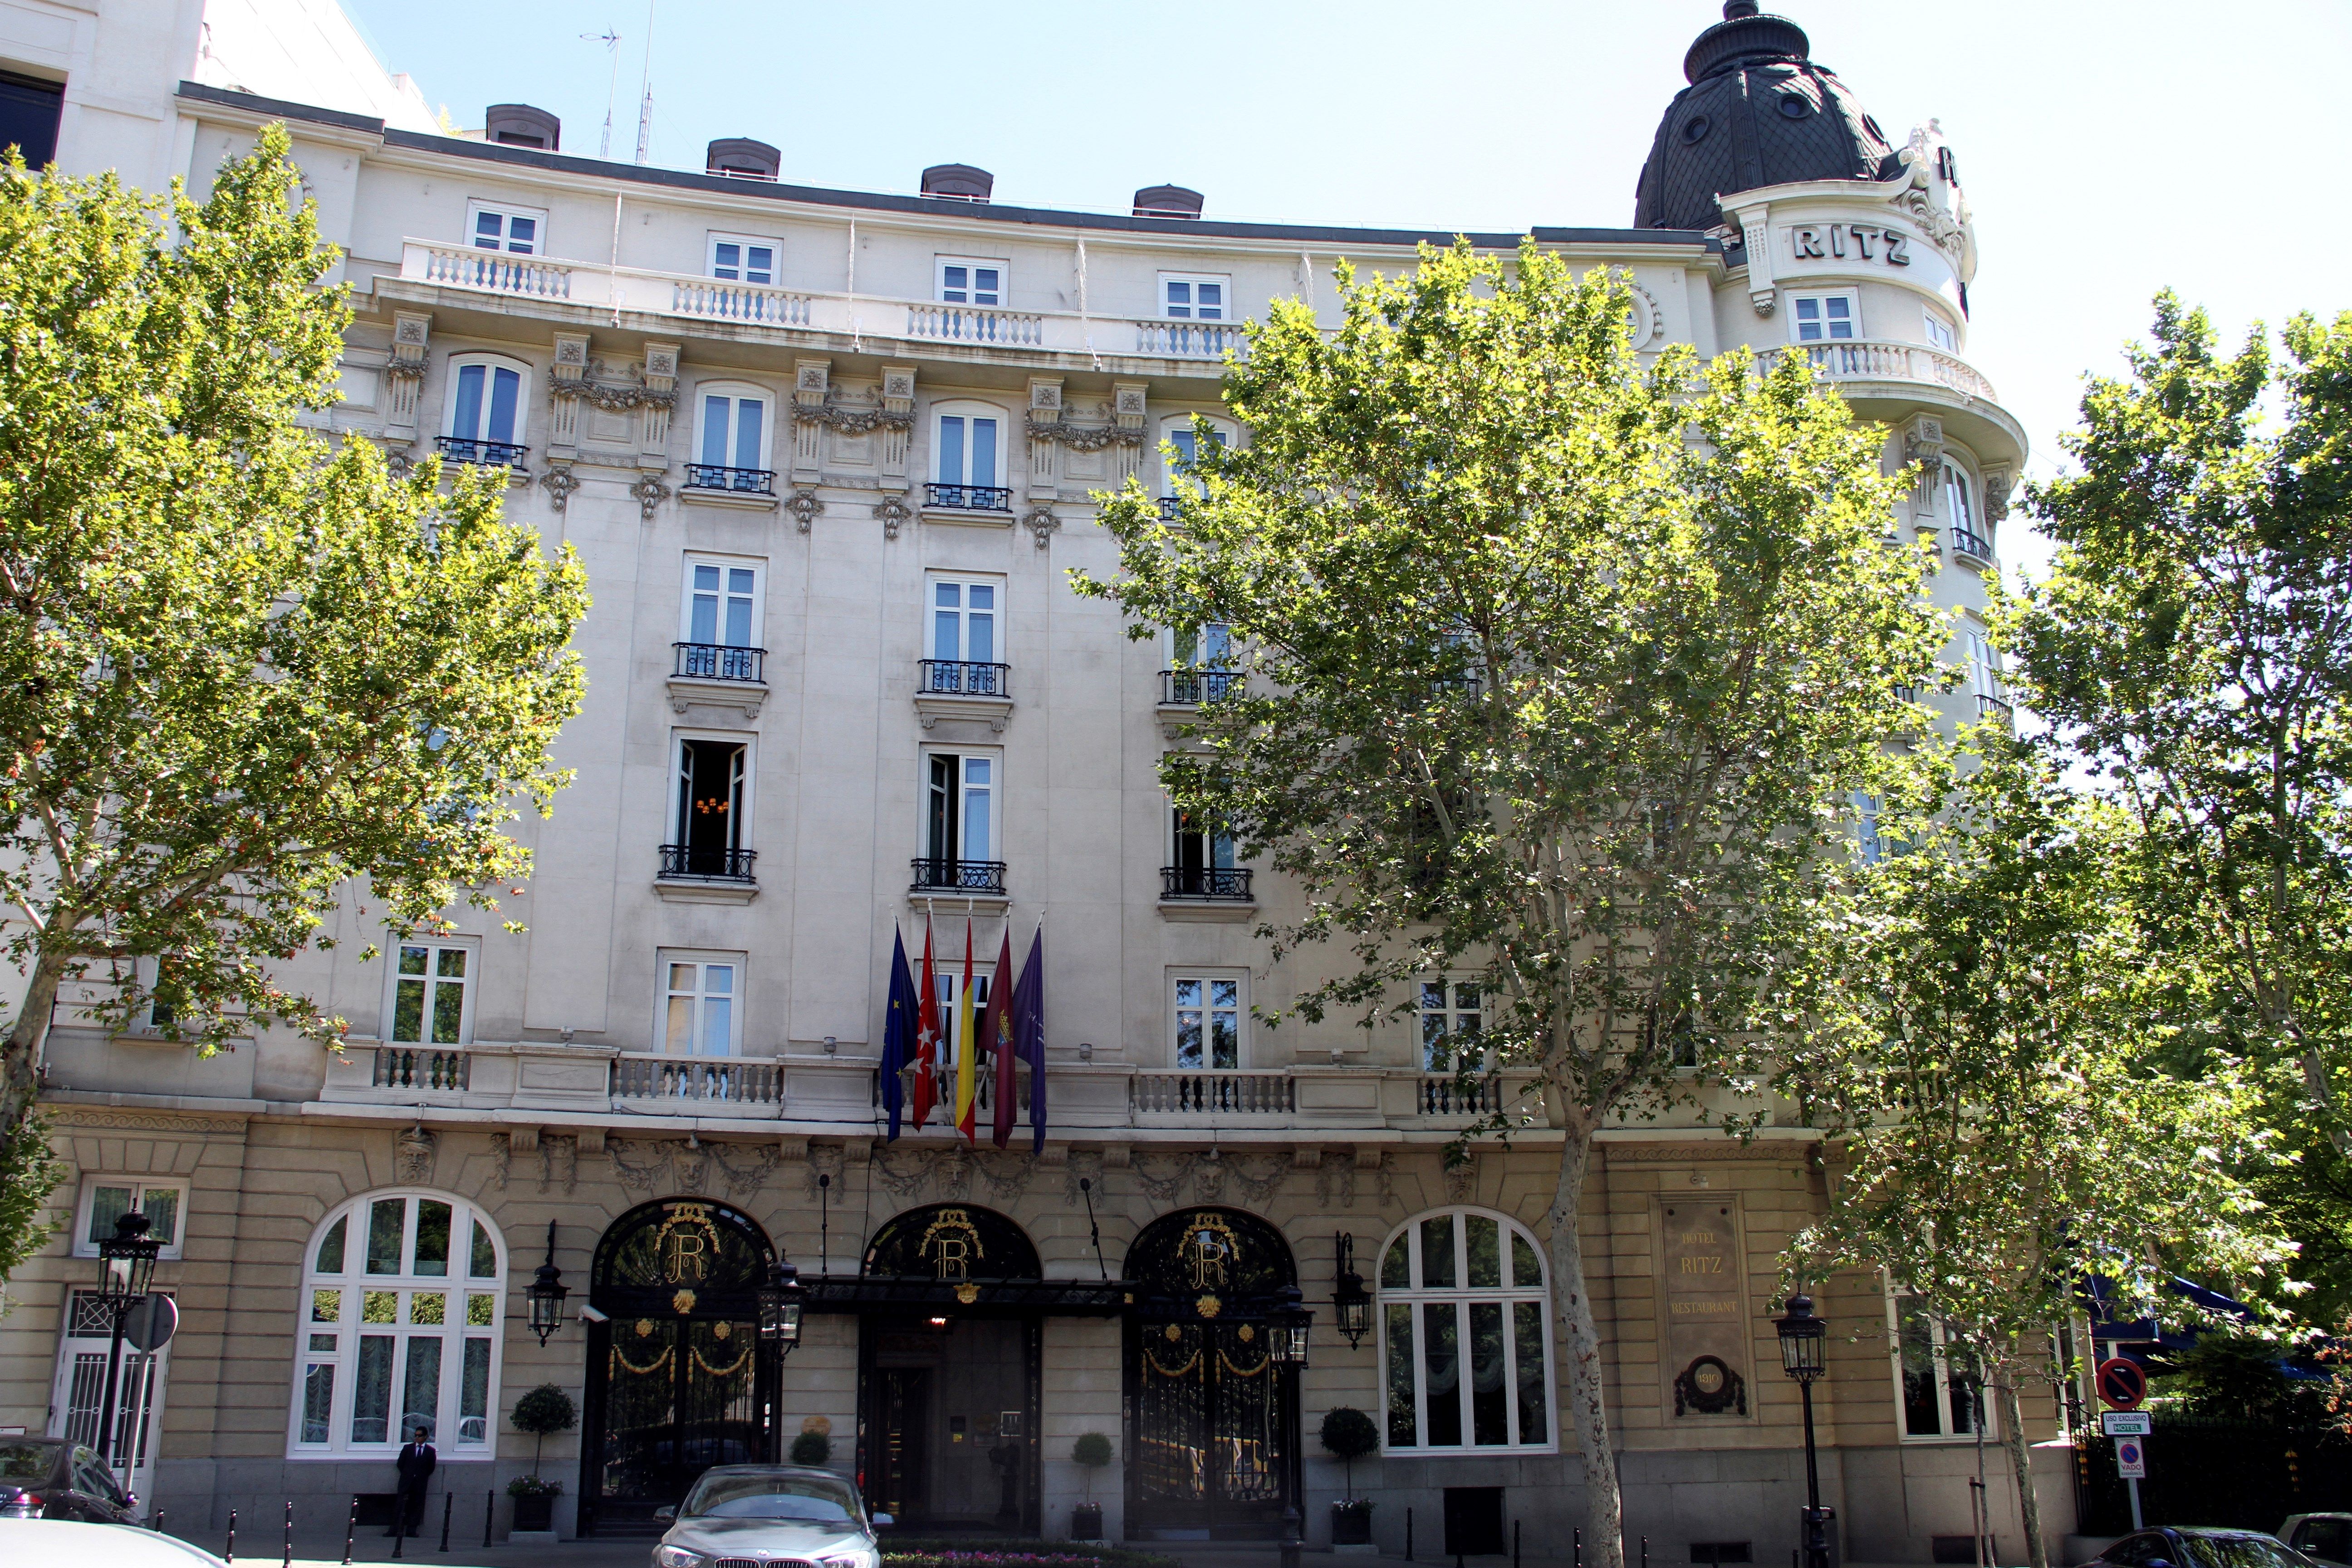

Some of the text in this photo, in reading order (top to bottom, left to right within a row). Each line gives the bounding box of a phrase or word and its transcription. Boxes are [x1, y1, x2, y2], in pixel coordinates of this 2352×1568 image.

[1792, 225, 1910, 266] RITZ
[1682, 1232, 1717, 1244] HOTEL
[1681, 1257, 1722, 1274] RITZ
[1671, 1301, 1737, 1314] RESTAURANT
[1700, 1374, 1719, 1383] 1910
